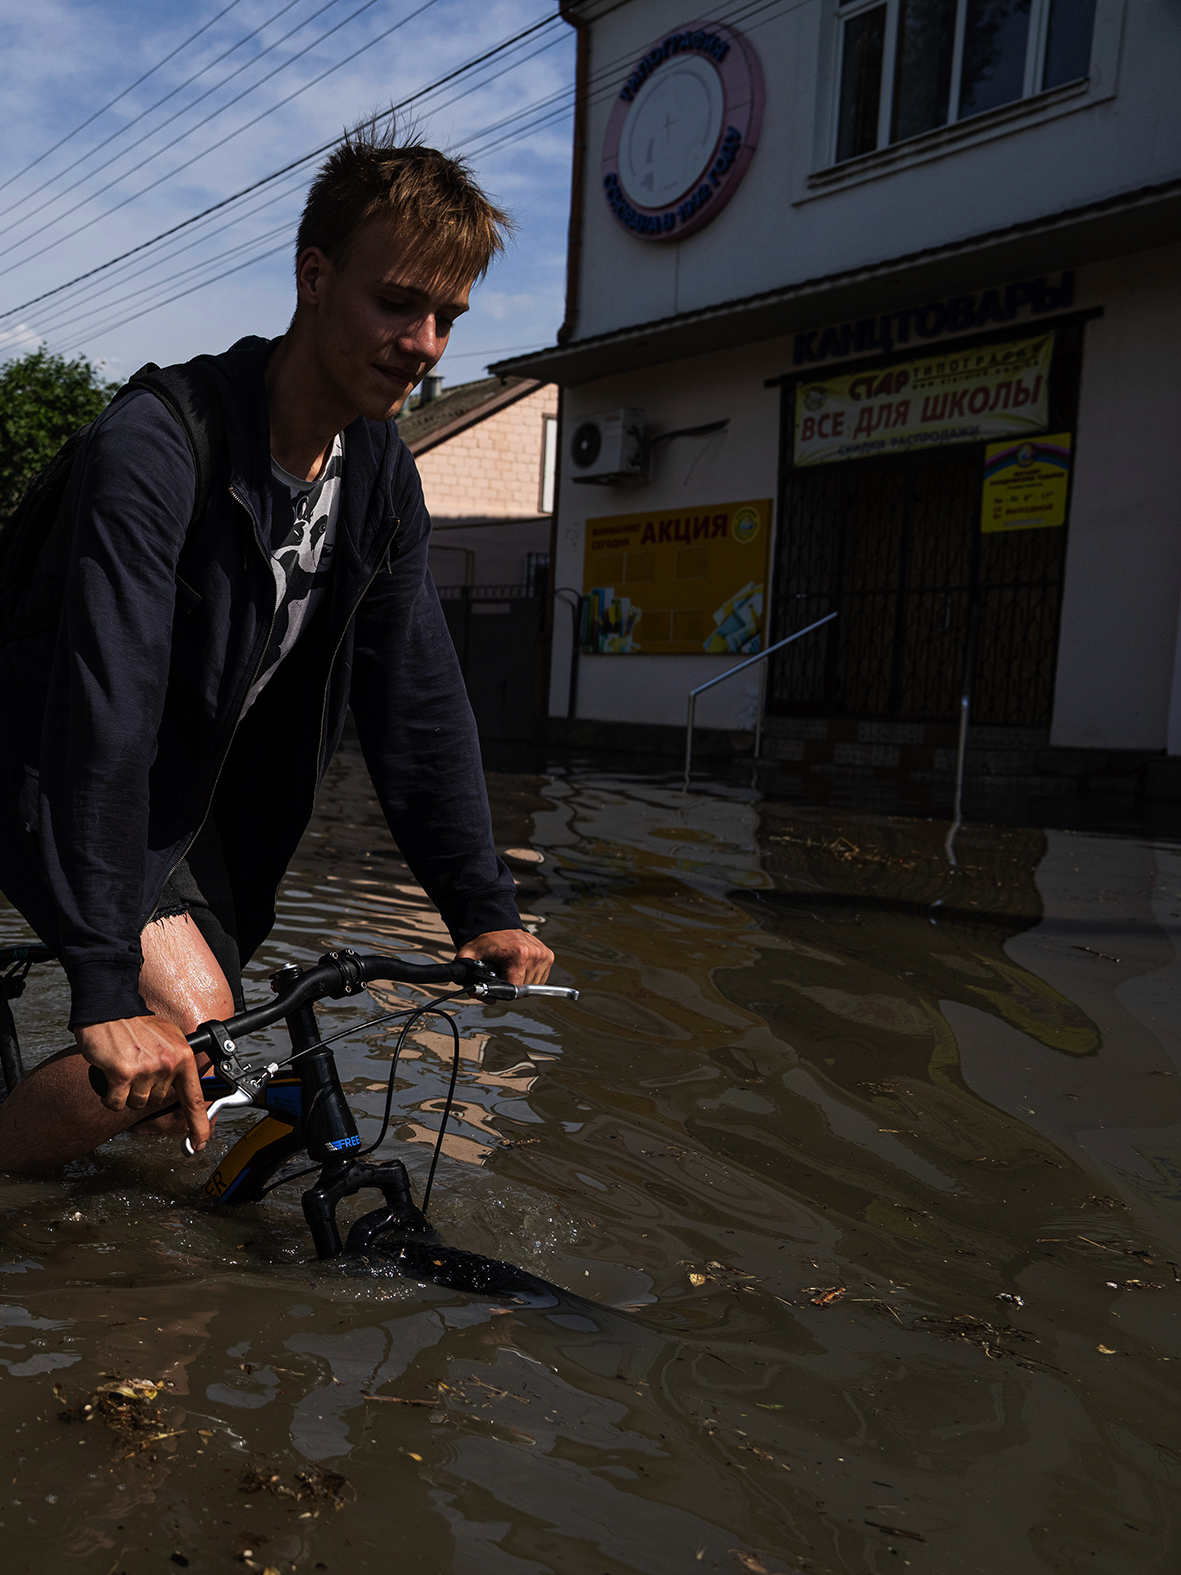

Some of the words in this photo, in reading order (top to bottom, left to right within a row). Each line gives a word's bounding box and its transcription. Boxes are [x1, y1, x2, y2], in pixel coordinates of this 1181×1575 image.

[620, 30, 730, 101] ТИПОГРАФИЯ
[604, 173, 661, 234] ОСНОВАНА
[663, 212, 676, 231] В
[708, 126, 741, 187] ГОДУ
[793, 271, 1076, 365] КАНЦТОВАРЫ
[801, 411, 845, 442] ВСЕ
[853, 400, 911, 440] ДЛЯ
[920, 375, 1044, 423] ШКОЛЫ
[849, 370, 910, 401] СТАР
[641, 513, 728, 545] АКЦИЯ
[12, 947, 29, 959] X10
